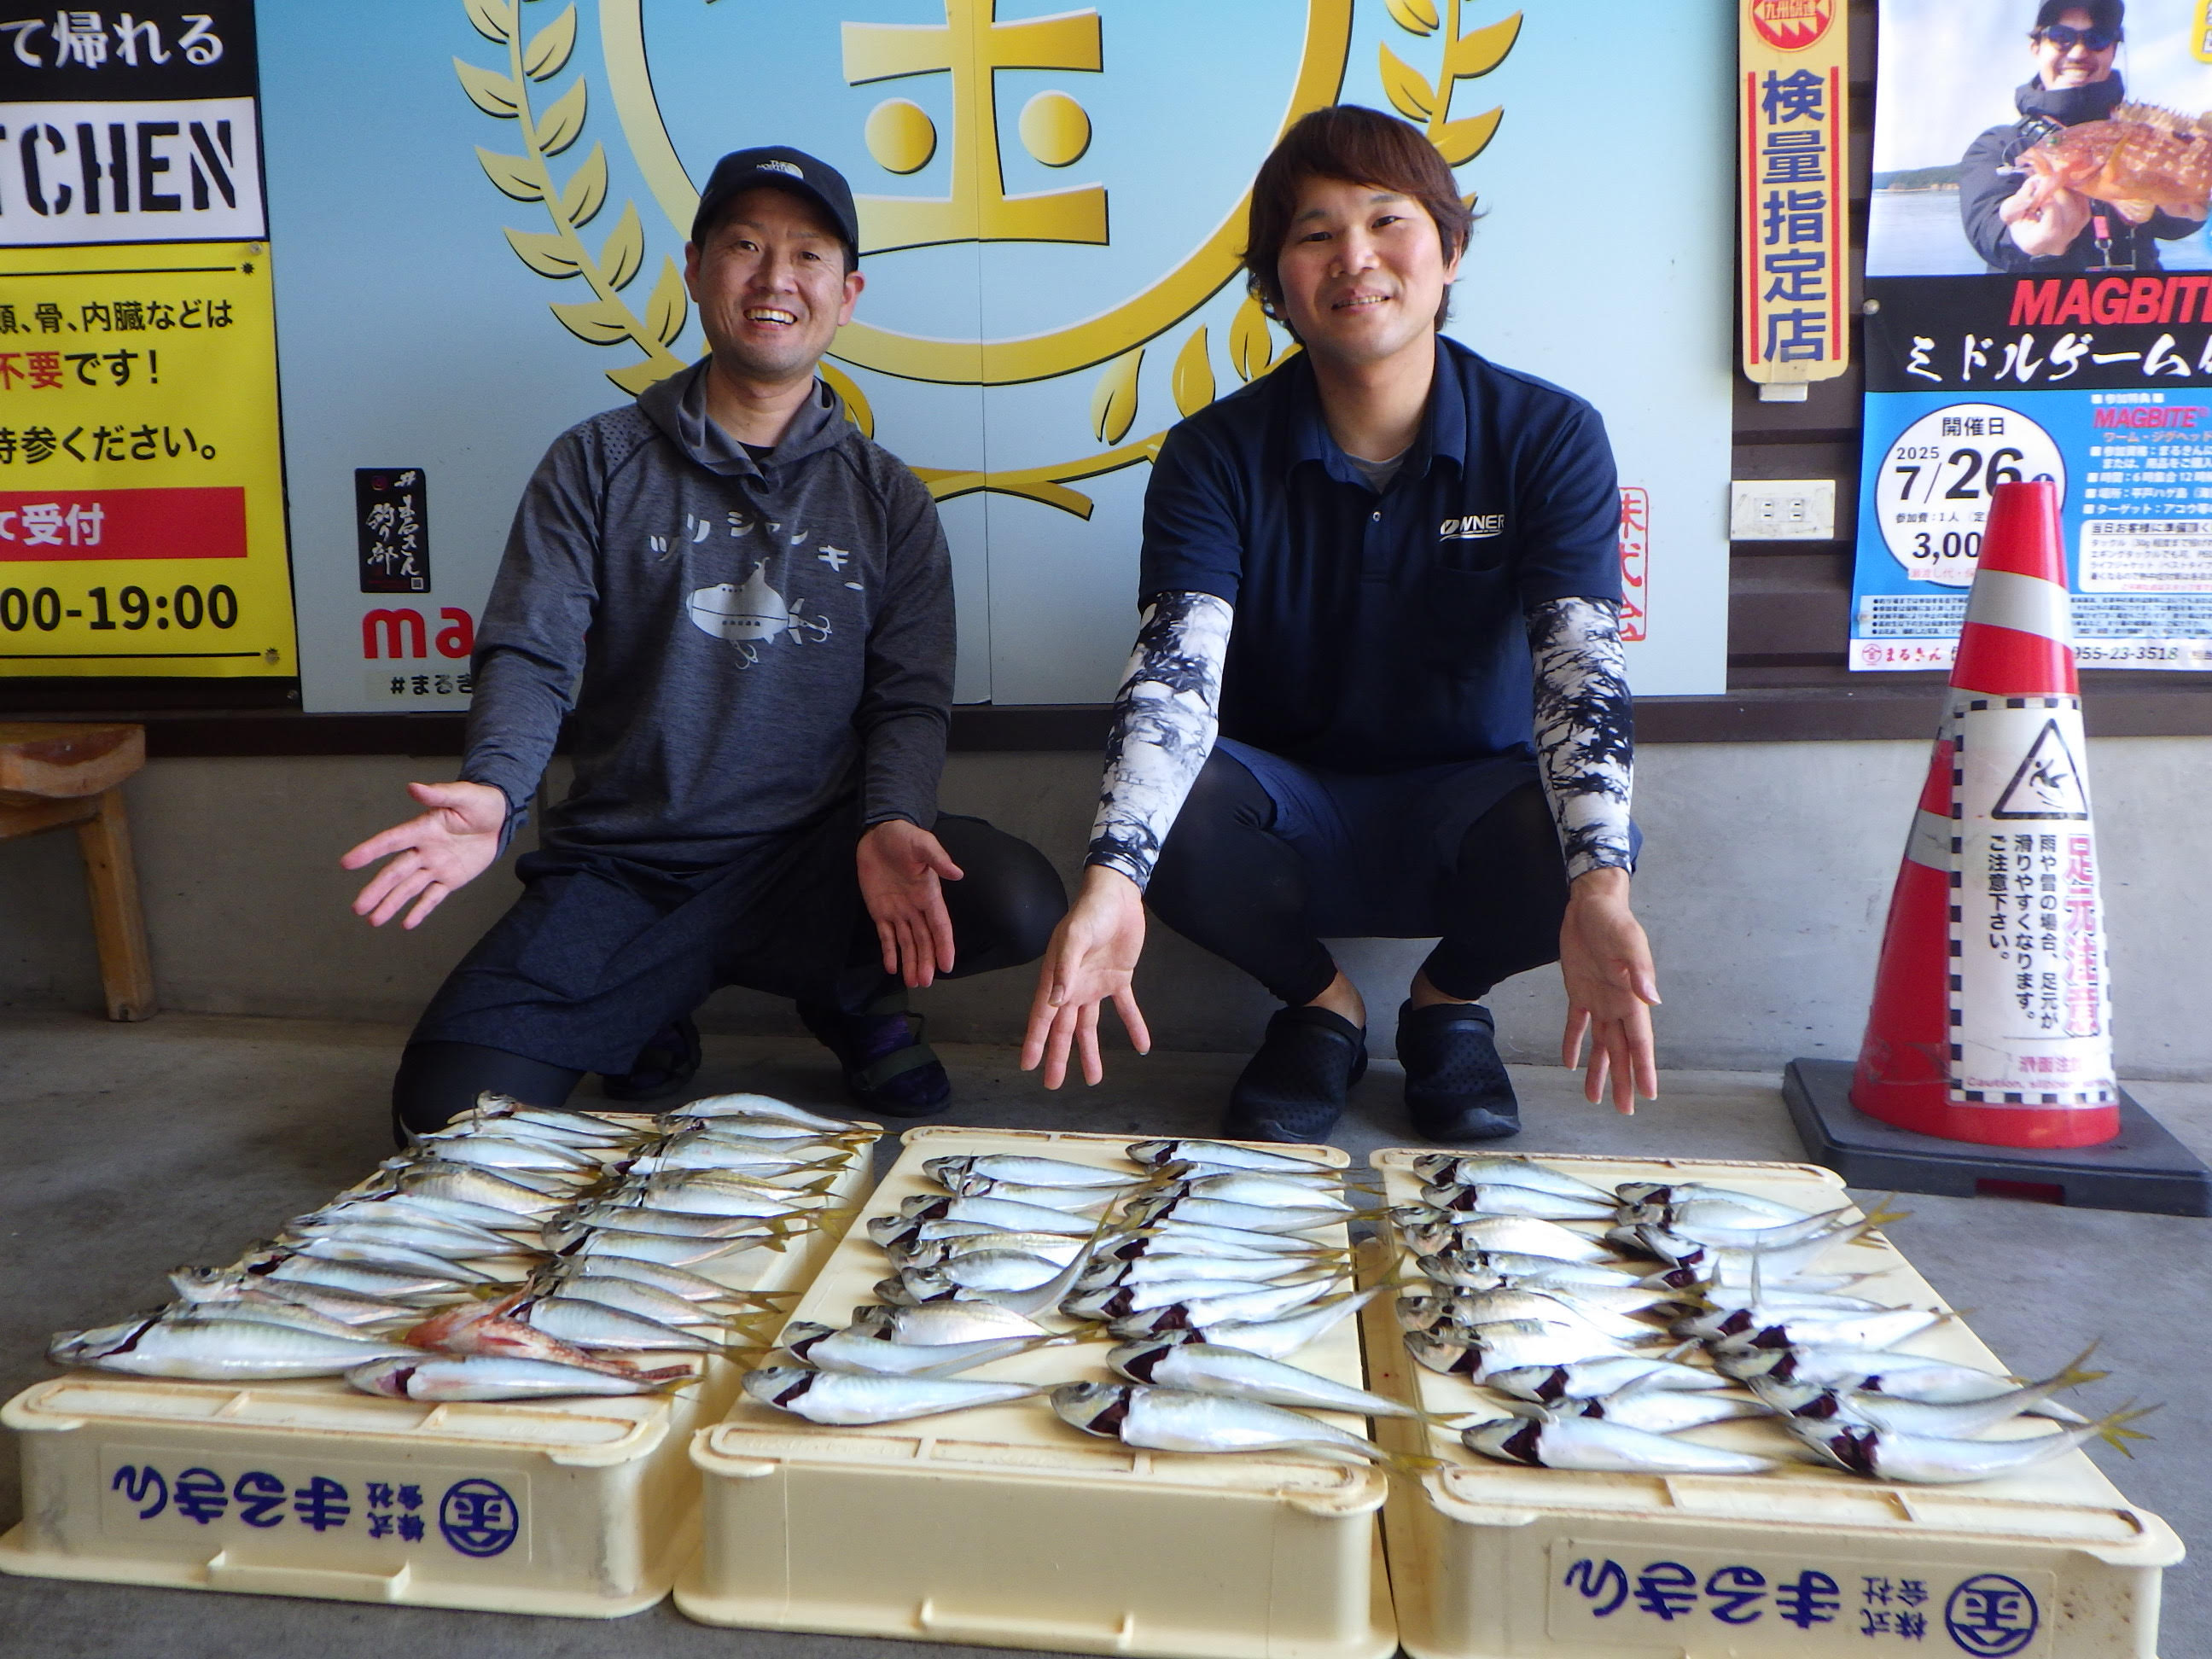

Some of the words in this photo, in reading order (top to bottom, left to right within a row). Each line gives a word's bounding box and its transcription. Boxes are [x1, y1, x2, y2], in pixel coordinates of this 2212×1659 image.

[0, 9, 224, 69] て帰れる
[0, 119, 236, 216] CHEN
[1761, 69, 1827, 364] 検量指定店
[1896, 446, 1940, 460] 2025
[1941, 416, 2005, 437] 開催日
[1440, 514, 1505, 537] OWNER
[0, 584, 238, 632] 00-19:00
[1988, 835, 2010, 960] ご注意下さい。
[2014, 834, 2035, 1019] 滑りやすくなります。
[112, 1464, 351, 1532] まるきん
[1563, 1558, 1842, 1630] まるきん
